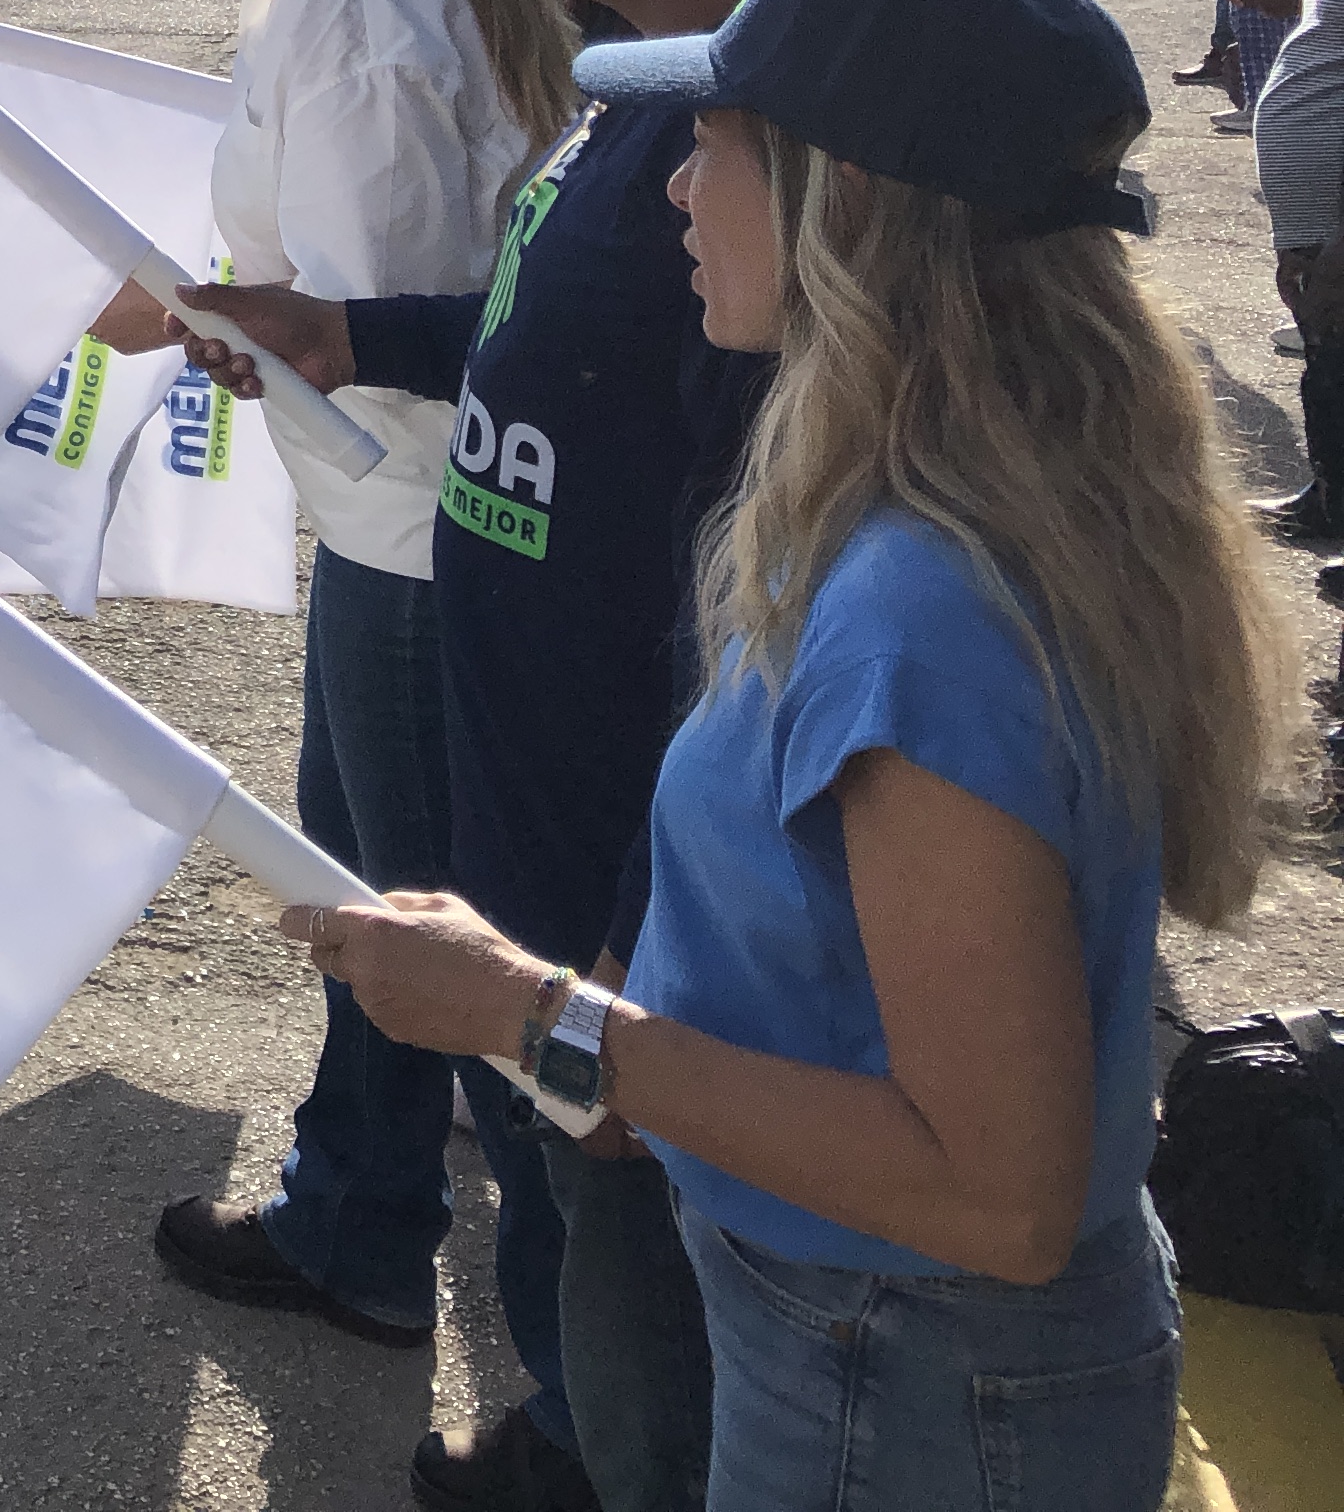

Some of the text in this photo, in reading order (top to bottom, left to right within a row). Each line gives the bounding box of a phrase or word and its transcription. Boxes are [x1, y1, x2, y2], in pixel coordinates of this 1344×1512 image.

[63, 353, 102, 461] CONTIGO
[213, 387, 231, 474] CONTIG
[453, 485, 537, 546] MEJOR
